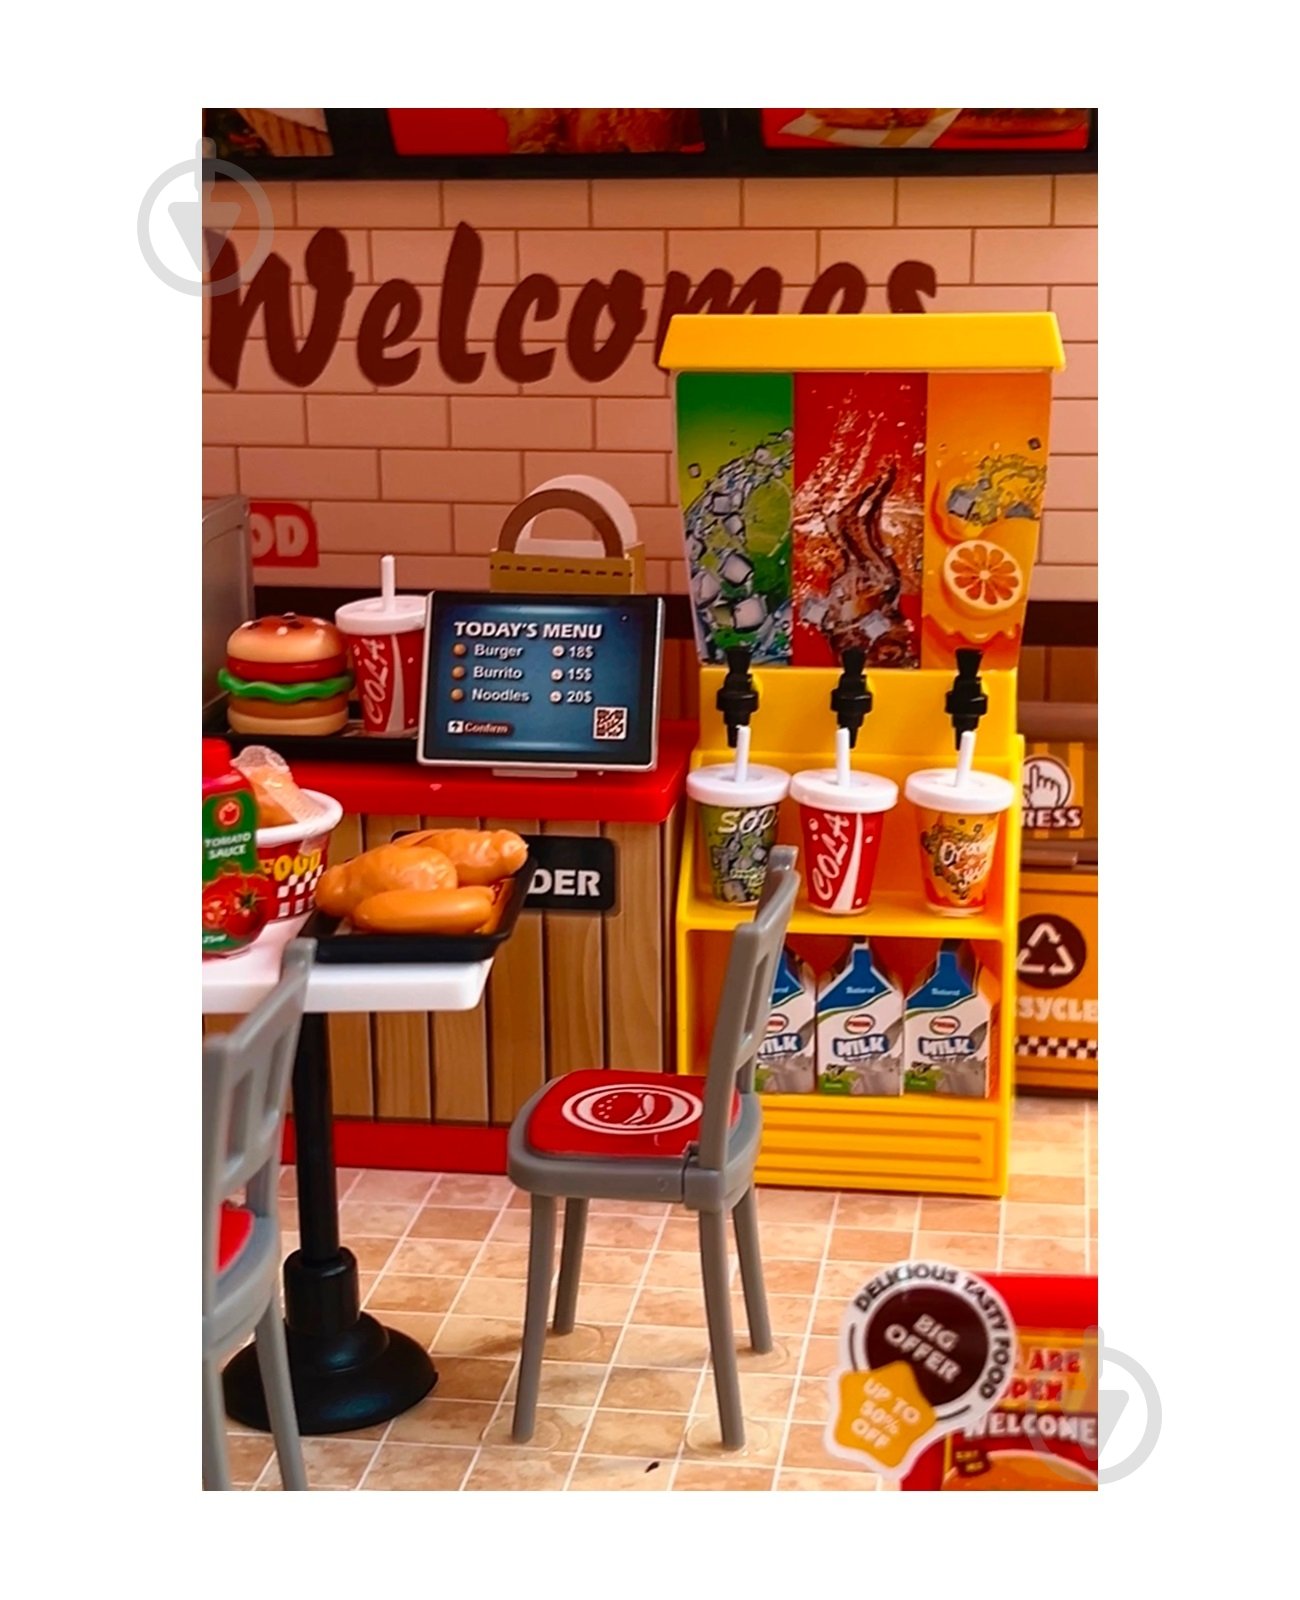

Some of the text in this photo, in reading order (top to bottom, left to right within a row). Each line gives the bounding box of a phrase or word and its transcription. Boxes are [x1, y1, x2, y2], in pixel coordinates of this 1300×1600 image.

[453, 621, 603, 639] TODAY'S MENU
[474, 644, 594, 660] Burger 18$
[363, 638, 388, 725] COLA
[473, 666, 592, 681] Burrito 15$
[472, 689, 592, 703] Noodles 20$
[718, 805, 778, 834] SOD
[1021, 808, 1082, 828] RESS
[205, 832, 252, 848] TOMATO
[208, 844, 247, 860] SAUCE
[812, 812, 849, 900] COLA
[527, 868, 600, 896] DER
[835, 1035, 886, 1057] MILK
[921, 1037, 974, 1056] MILK
[854, 1264, 1011, 1399] DELICIOUS TASTY FOOD
[913, 1313, 960, 1351] BIG
[884, 1324, 962, 1383] OFFER
[863, 1378, 921, 1424] UP TO
[1003, 1377, 1062, 1401] PEN
[851, 1418, 891, 1448] OFF
